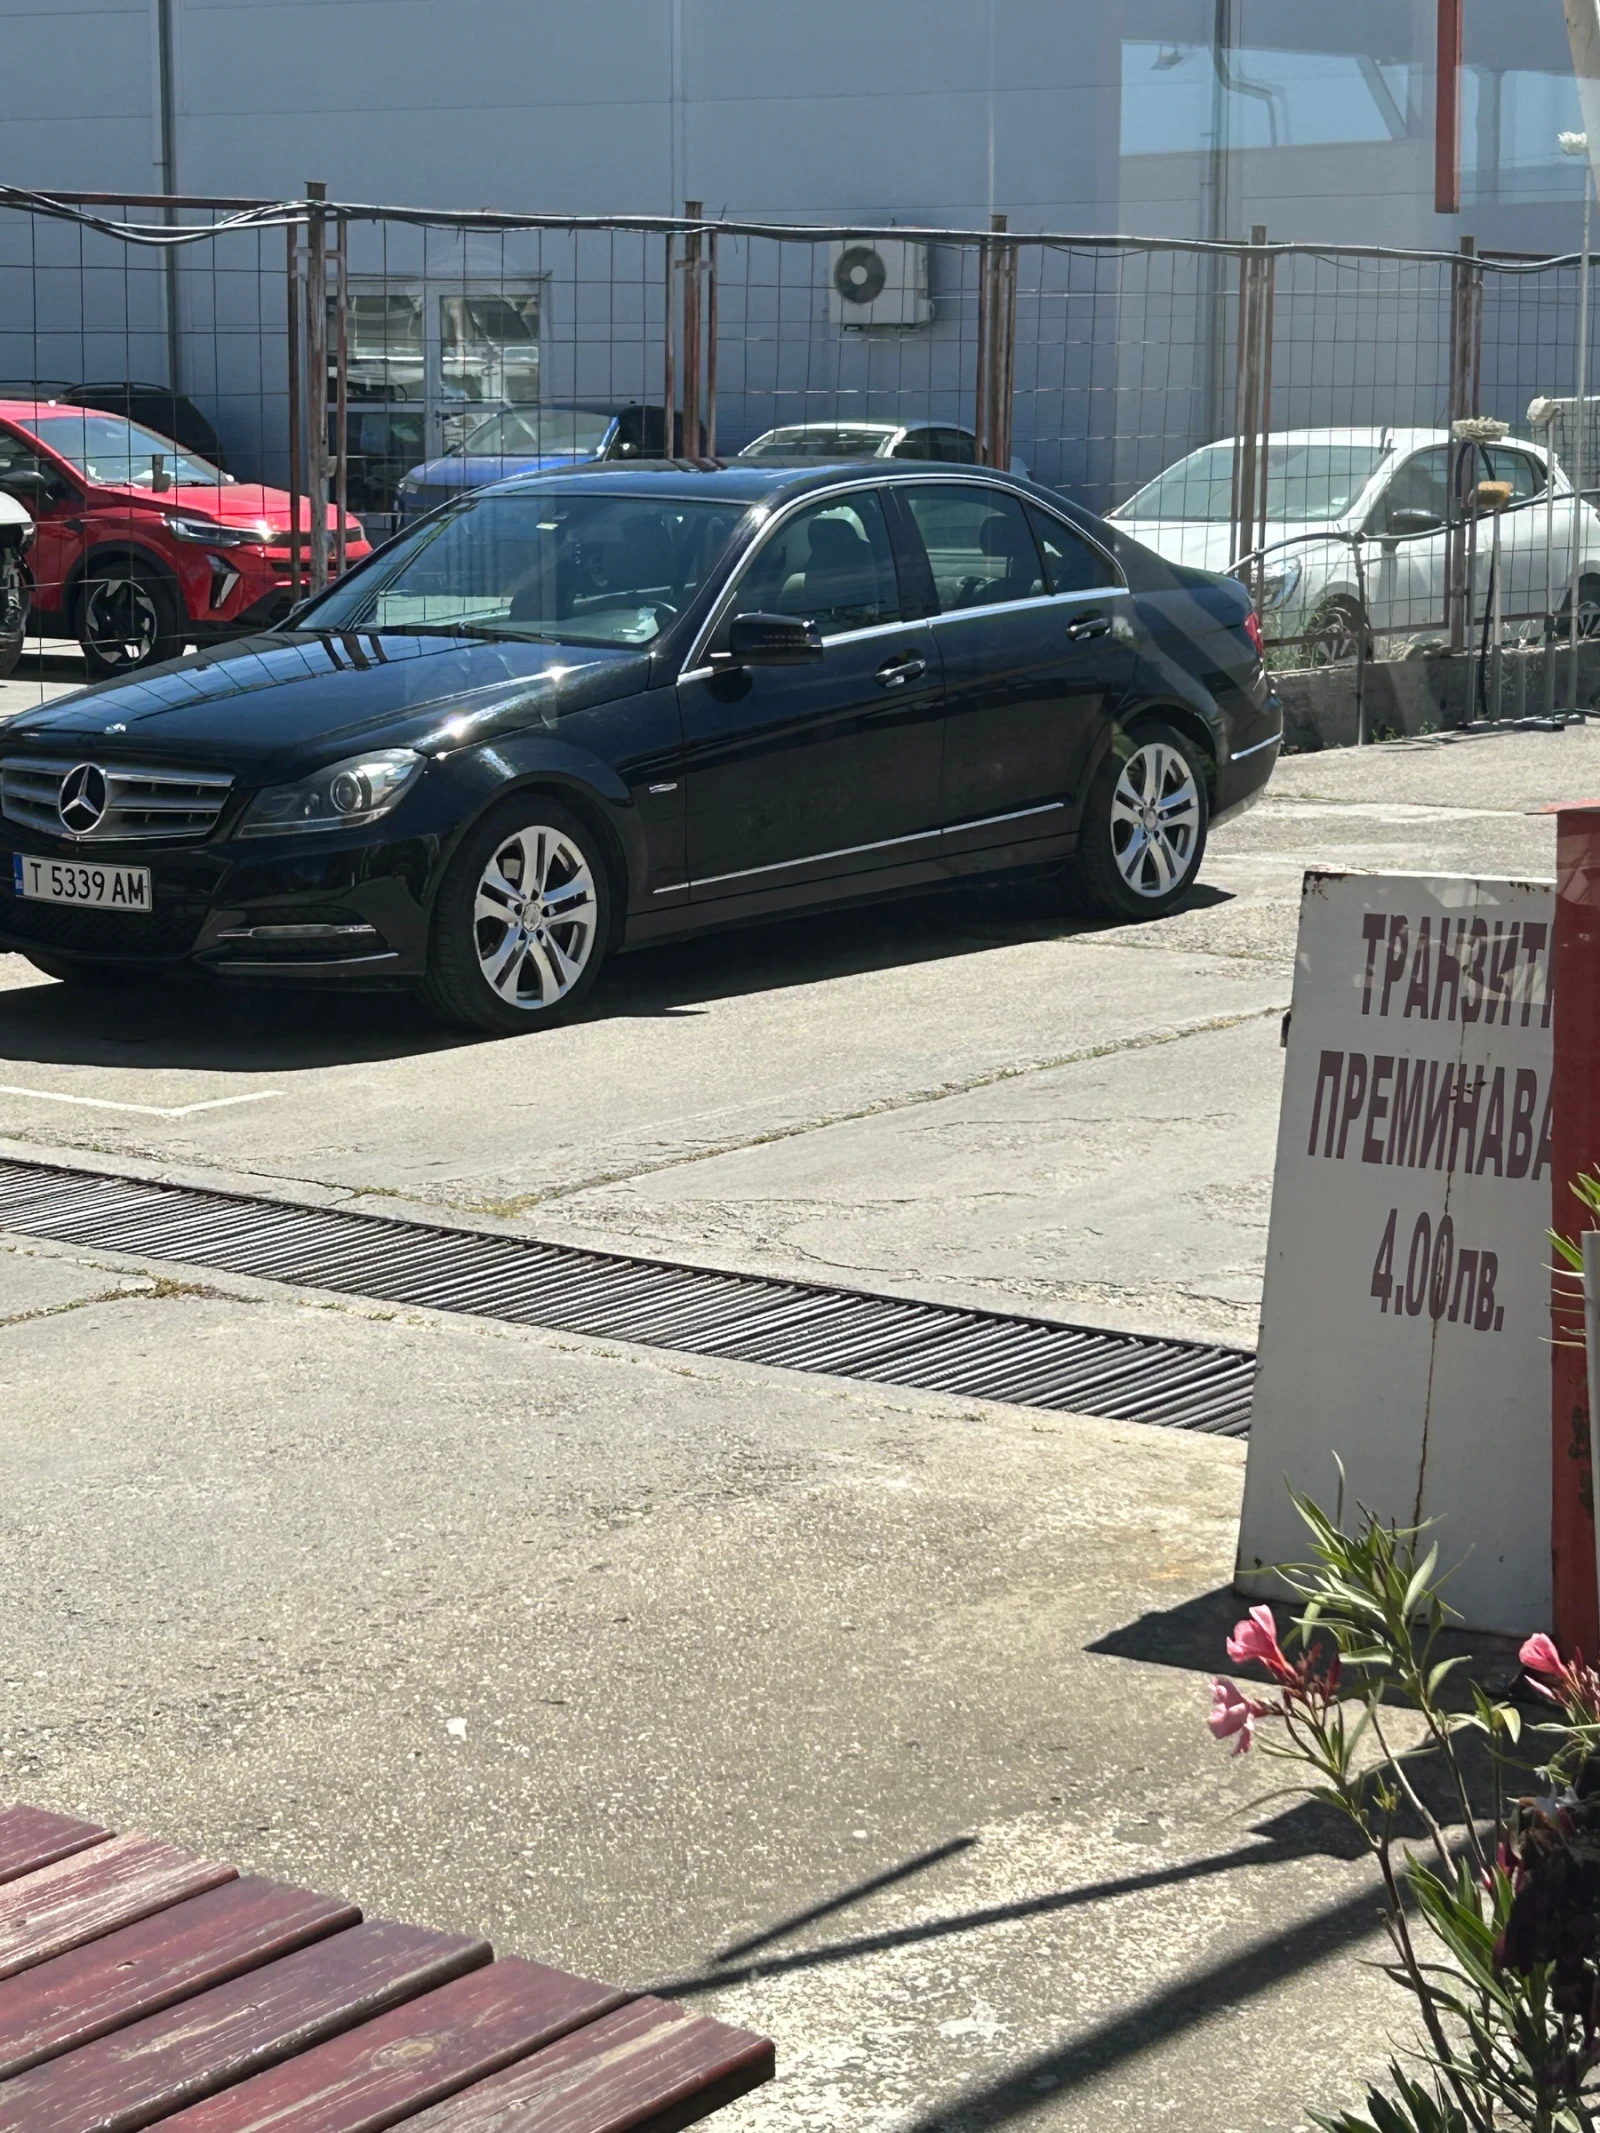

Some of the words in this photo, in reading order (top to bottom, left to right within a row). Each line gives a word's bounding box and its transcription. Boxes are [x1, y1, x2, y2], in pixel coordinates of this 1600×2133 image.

[29, 861, 42, 893] T
[51, 866, 105, 901] 5339
[112, 872, 144, 905] AM
